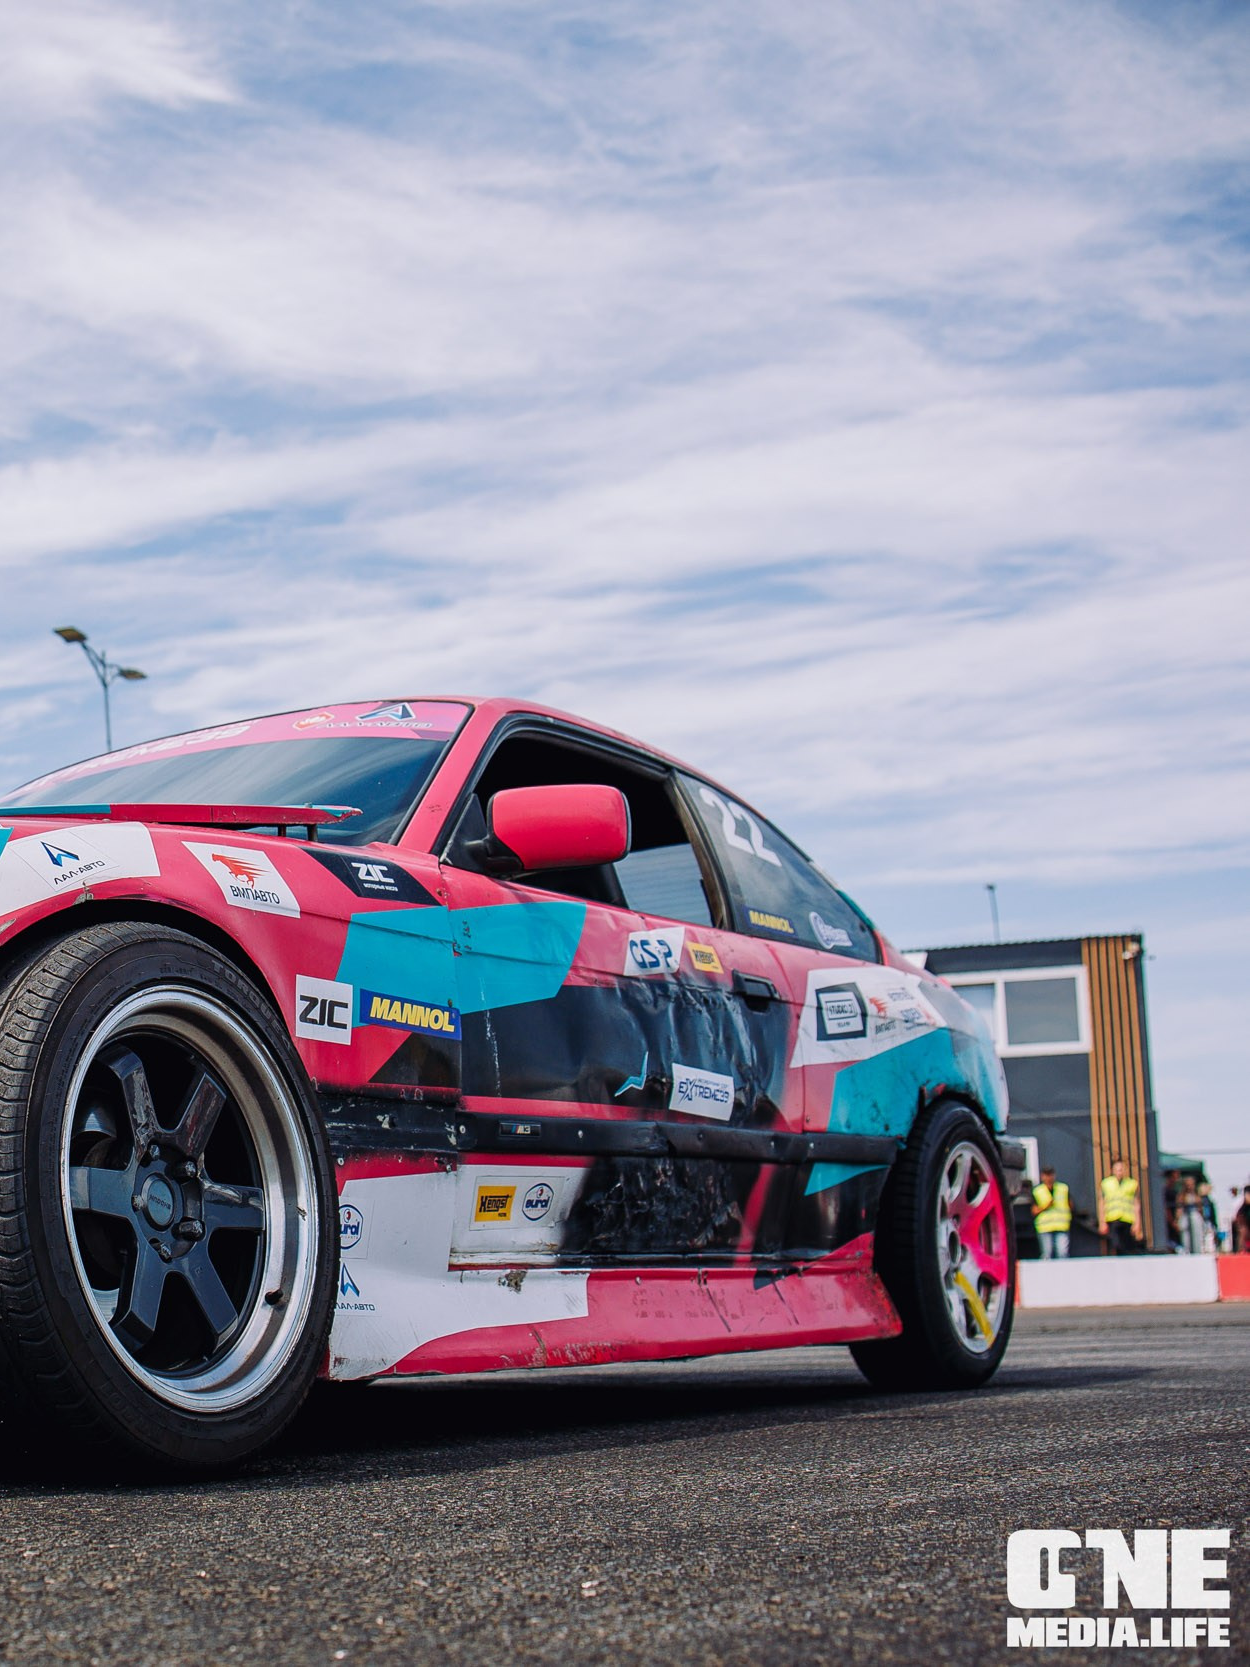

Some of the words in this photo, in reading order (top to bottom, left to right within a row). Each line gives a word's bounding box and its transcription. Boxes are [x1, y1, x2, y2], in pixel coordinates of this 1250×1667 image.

[700, 788, 782, 867] 22
[53, 860, 106, 885] ЛАЛ-АВТО
[351, 862, 395, 884] ZIC
[230, 885, 281, 905] ВМПАВТО
[299, 995, 349, 1030] ZIC
[370, 996, 455, 1032] MANNOL
[340, 1221, 360, 1236] urol
